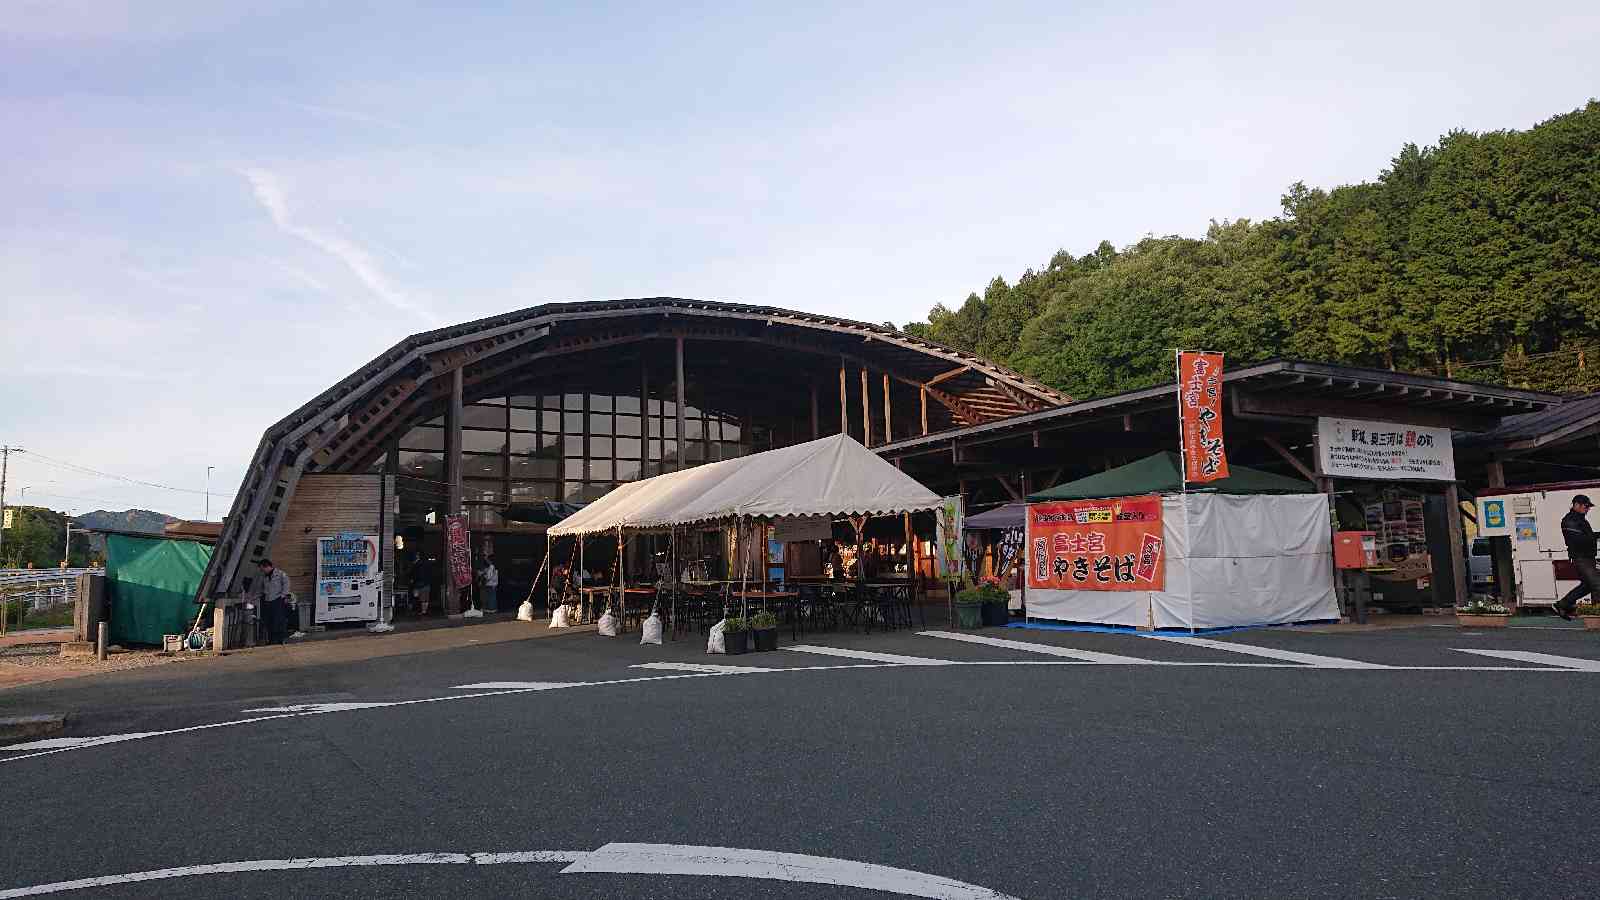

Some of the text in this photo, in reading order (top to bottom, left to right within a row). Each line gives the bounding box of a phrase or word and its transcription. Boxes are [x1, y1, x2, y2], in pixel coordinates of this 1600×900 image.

[1199, 406, 1224, 477] やきそば
[1053, 552, 1136, 583] やきそば
